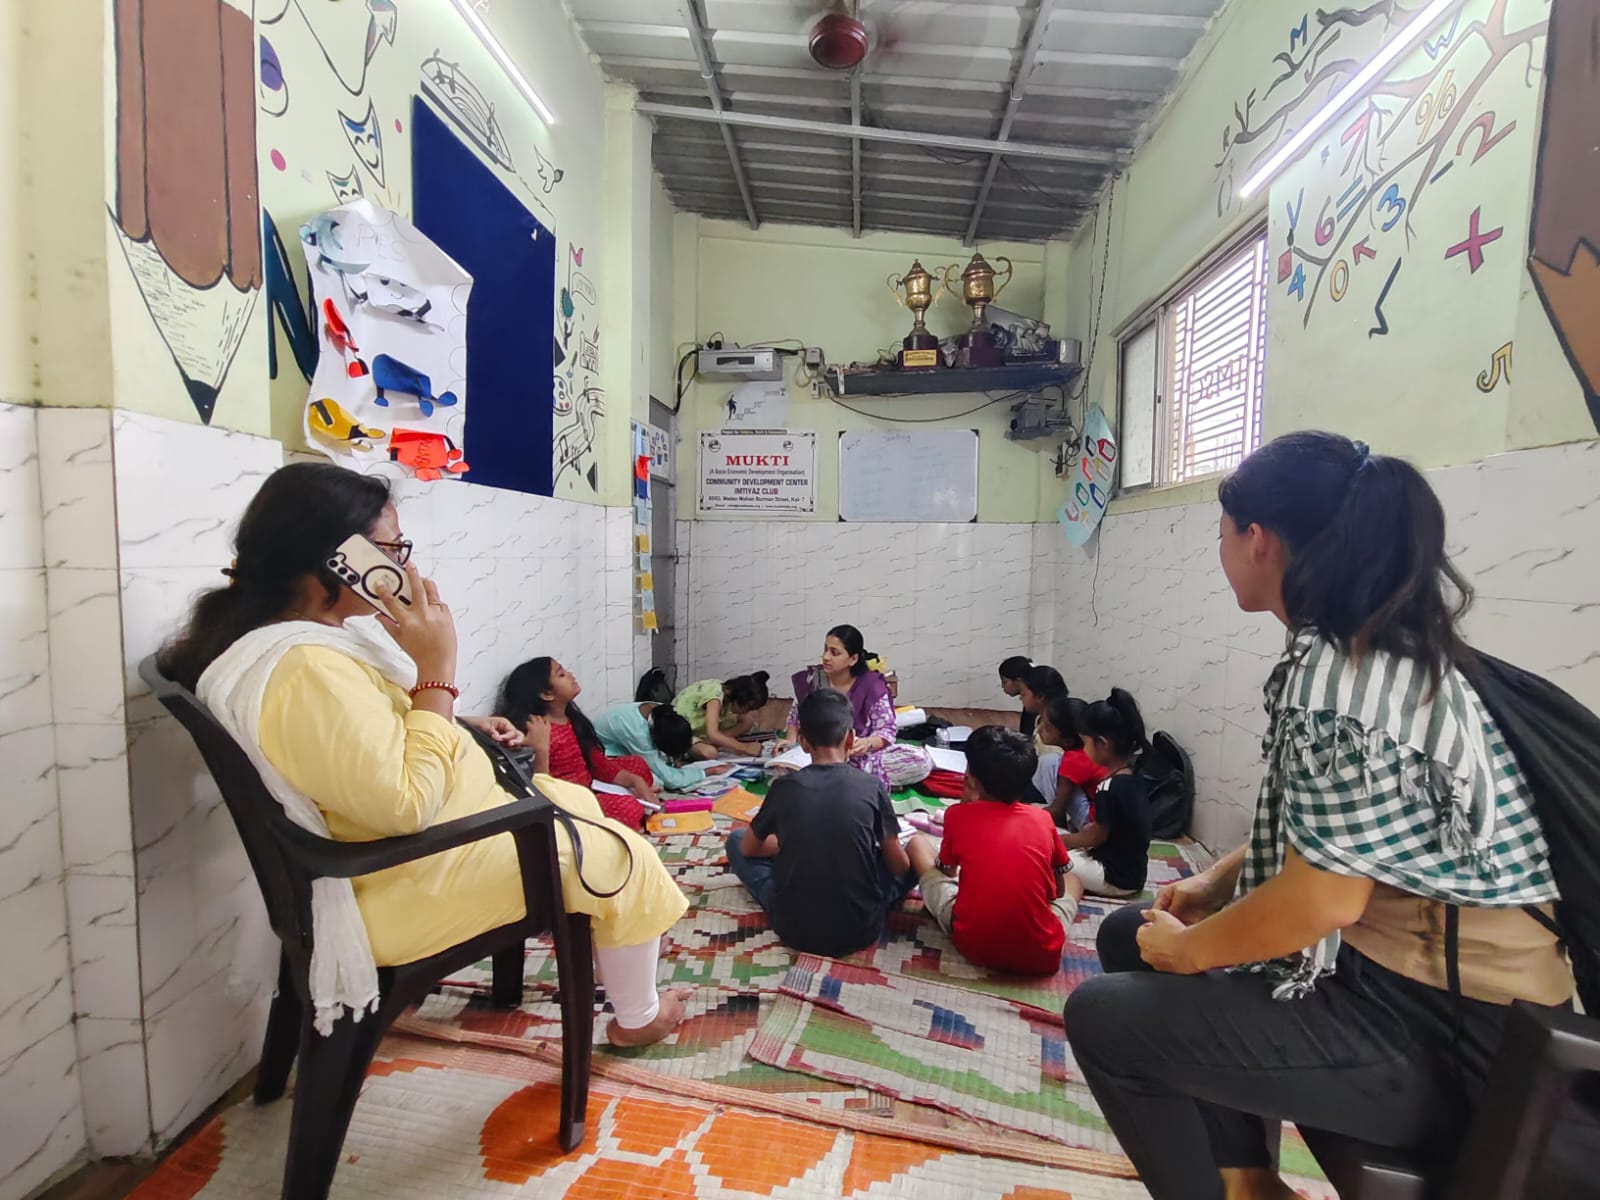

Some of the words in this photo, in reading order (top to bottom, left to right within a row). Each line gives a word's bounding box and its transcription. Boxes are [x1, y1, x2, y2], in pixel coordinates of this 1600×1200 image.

[725, 455, 790, 467] MUKTI
[706, 478, 741, 486] COMMUNITY
[742, 478, 784, 486] DEVELOPMENT
[785, 478, 808, 486] CENTER
